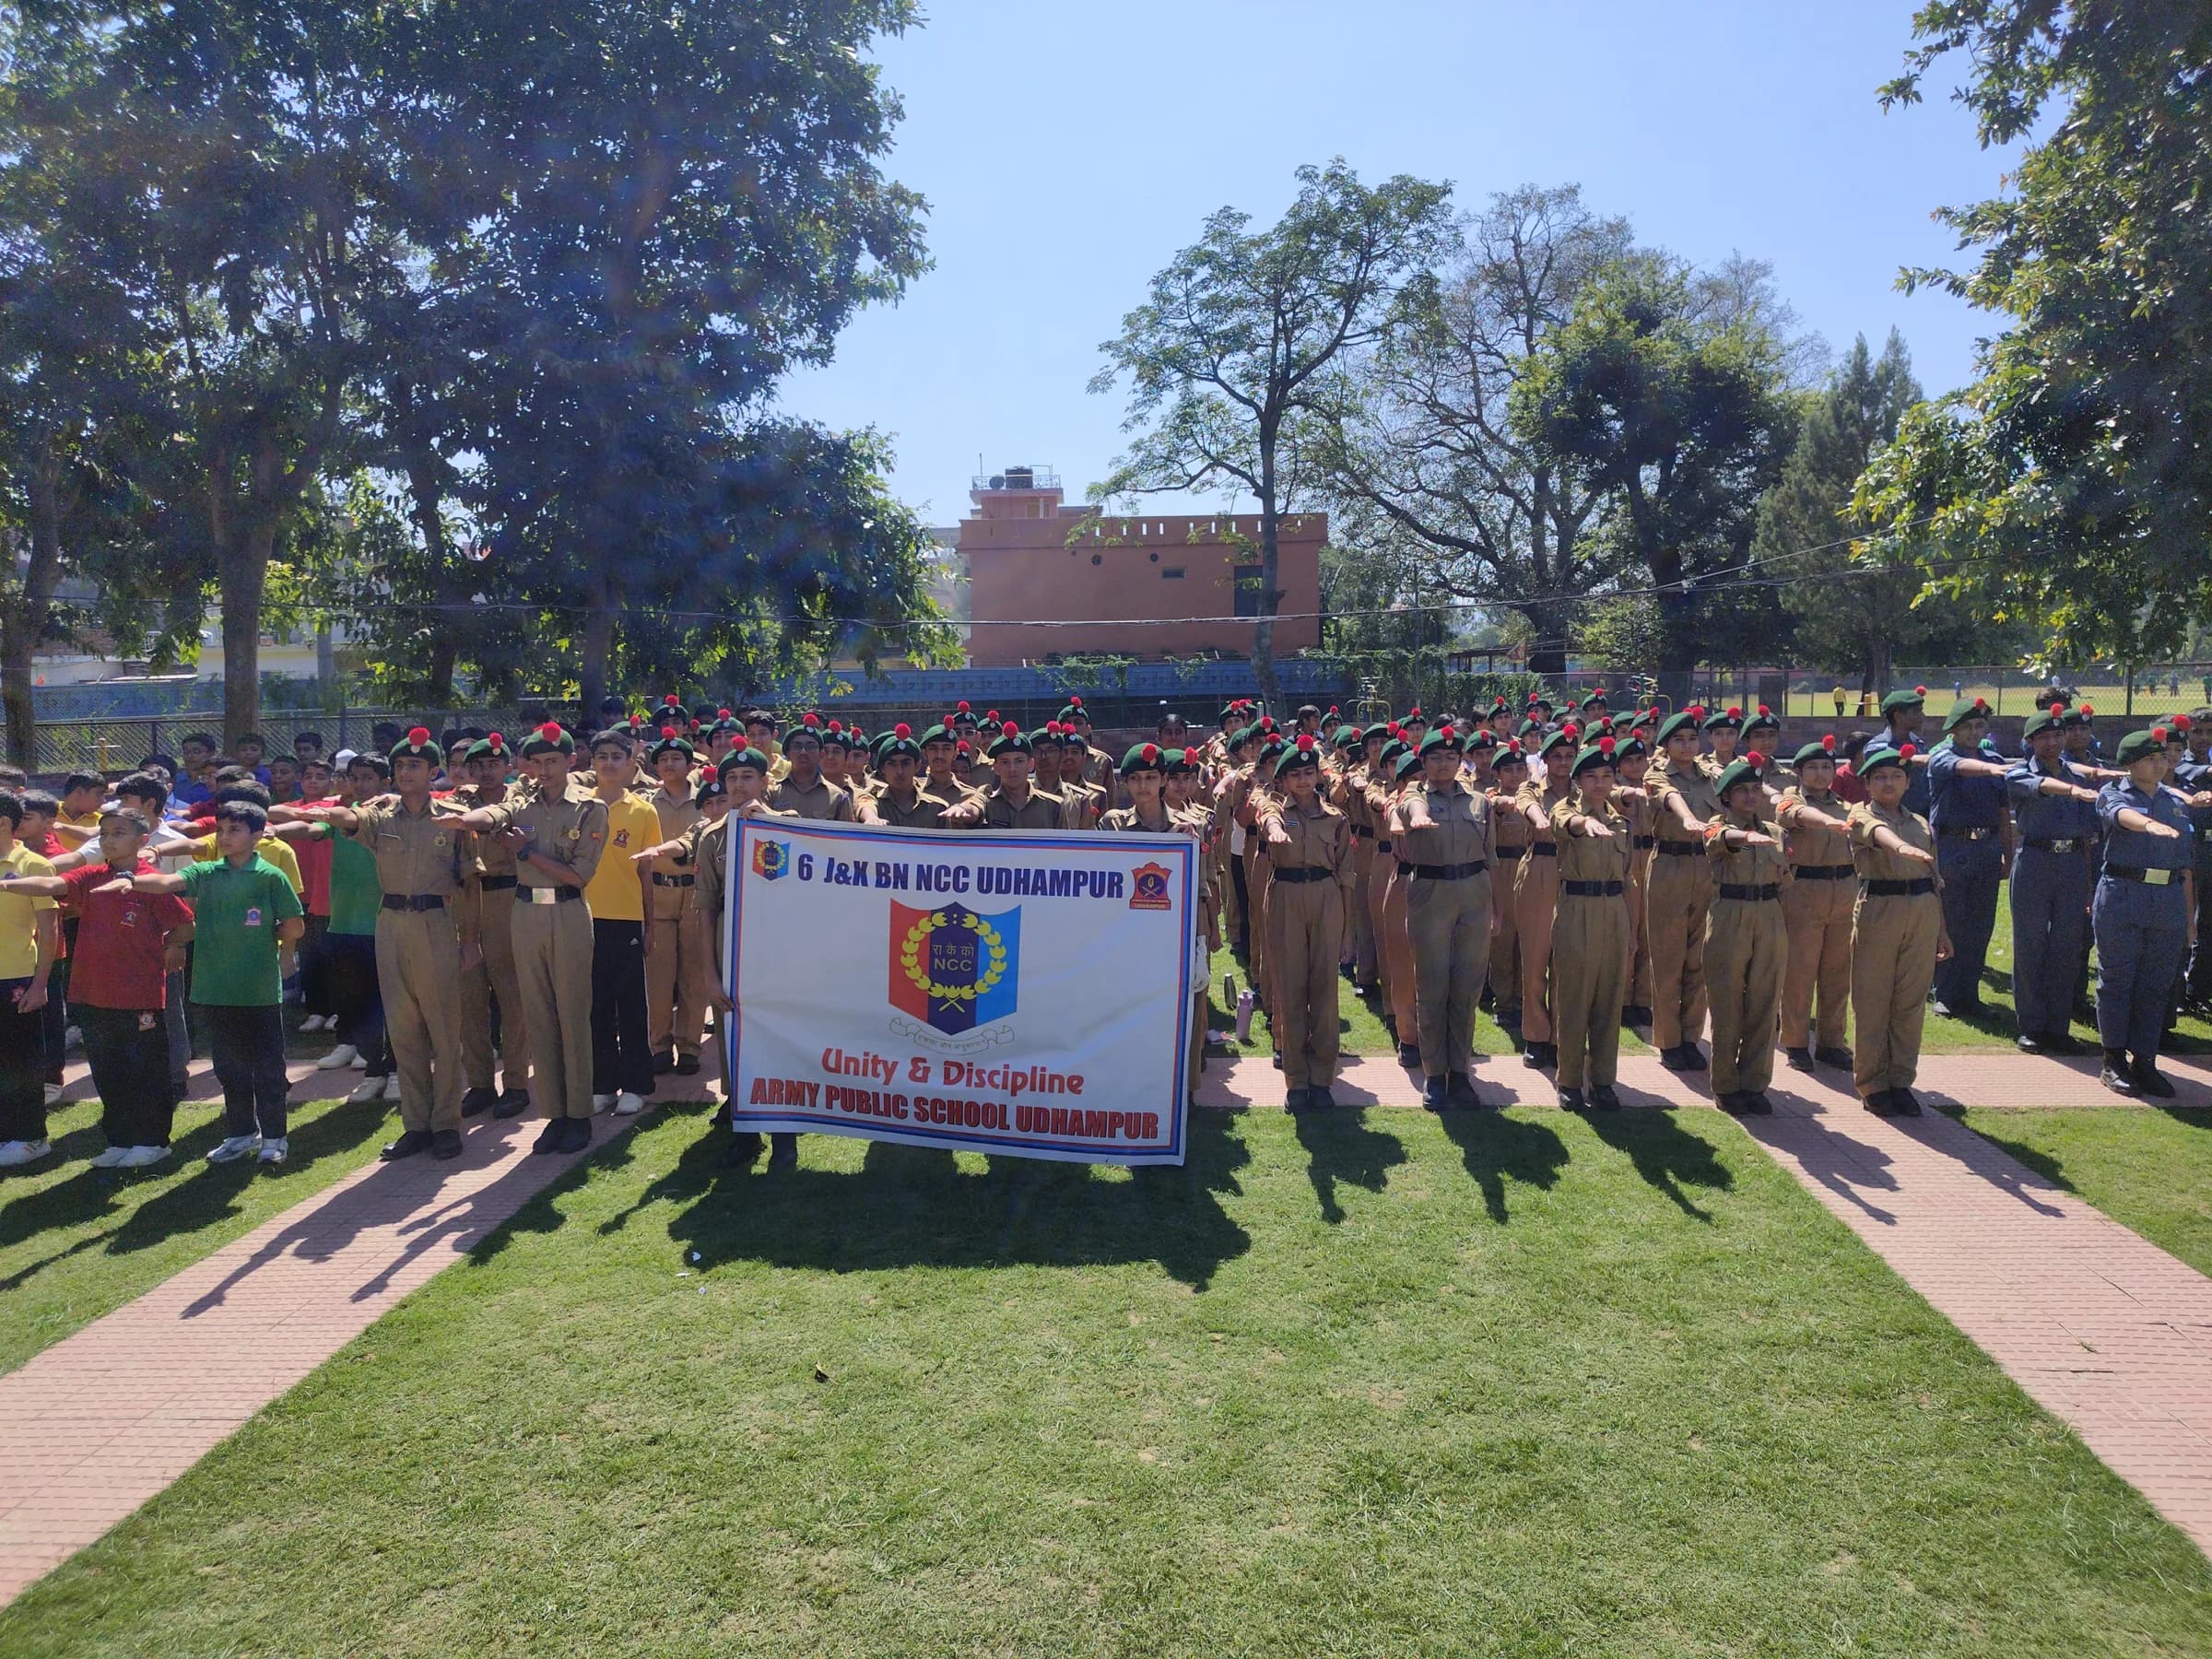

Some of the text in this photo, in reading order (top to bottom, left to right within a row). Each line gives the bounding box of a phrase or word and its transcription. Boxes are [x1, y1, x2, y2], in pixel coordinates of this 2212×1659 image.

[797, 853, 814, 881] 6
[823, 856, 868, 888] J&K
[874, 862, 909, 890] BN
[915, 864, 971, 893] NCC
[976, 865, 1124, 899] UDHAMPUR
[934, 958, 973, 972] NCC
[821, 1047, 1085, 1097] Unity & Discipline
[749, 1077, 1159, 1140] ARMY PUBLIC SCHOOL UDHAMPUR
